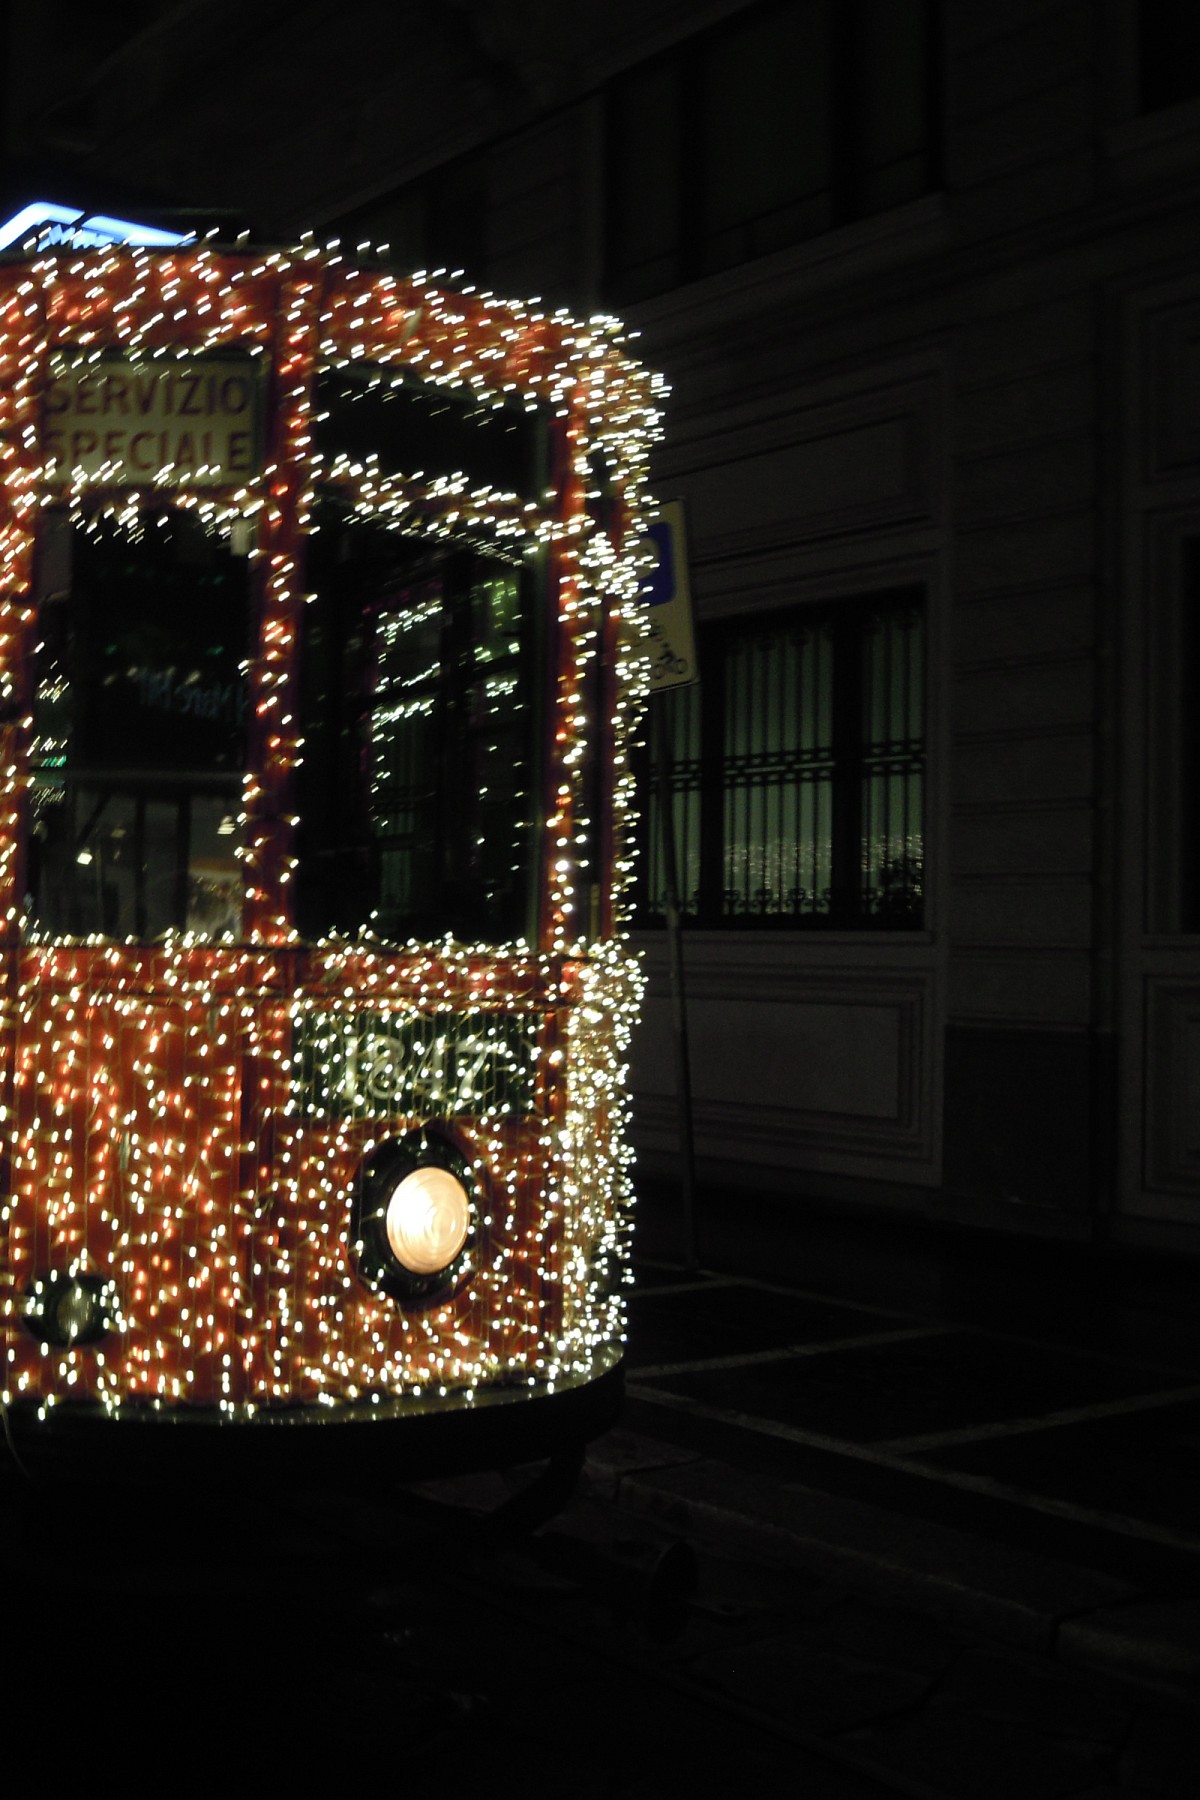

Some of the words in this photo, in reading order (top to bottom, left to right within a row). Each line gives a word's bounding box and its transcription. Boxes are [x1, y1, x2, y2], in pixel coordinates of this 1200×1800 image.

[44, 373, 250, 416] SERVIZIO
[44, 430, 251, 473] SPECIALE
[343, 1034, 502, 1100] 1847
